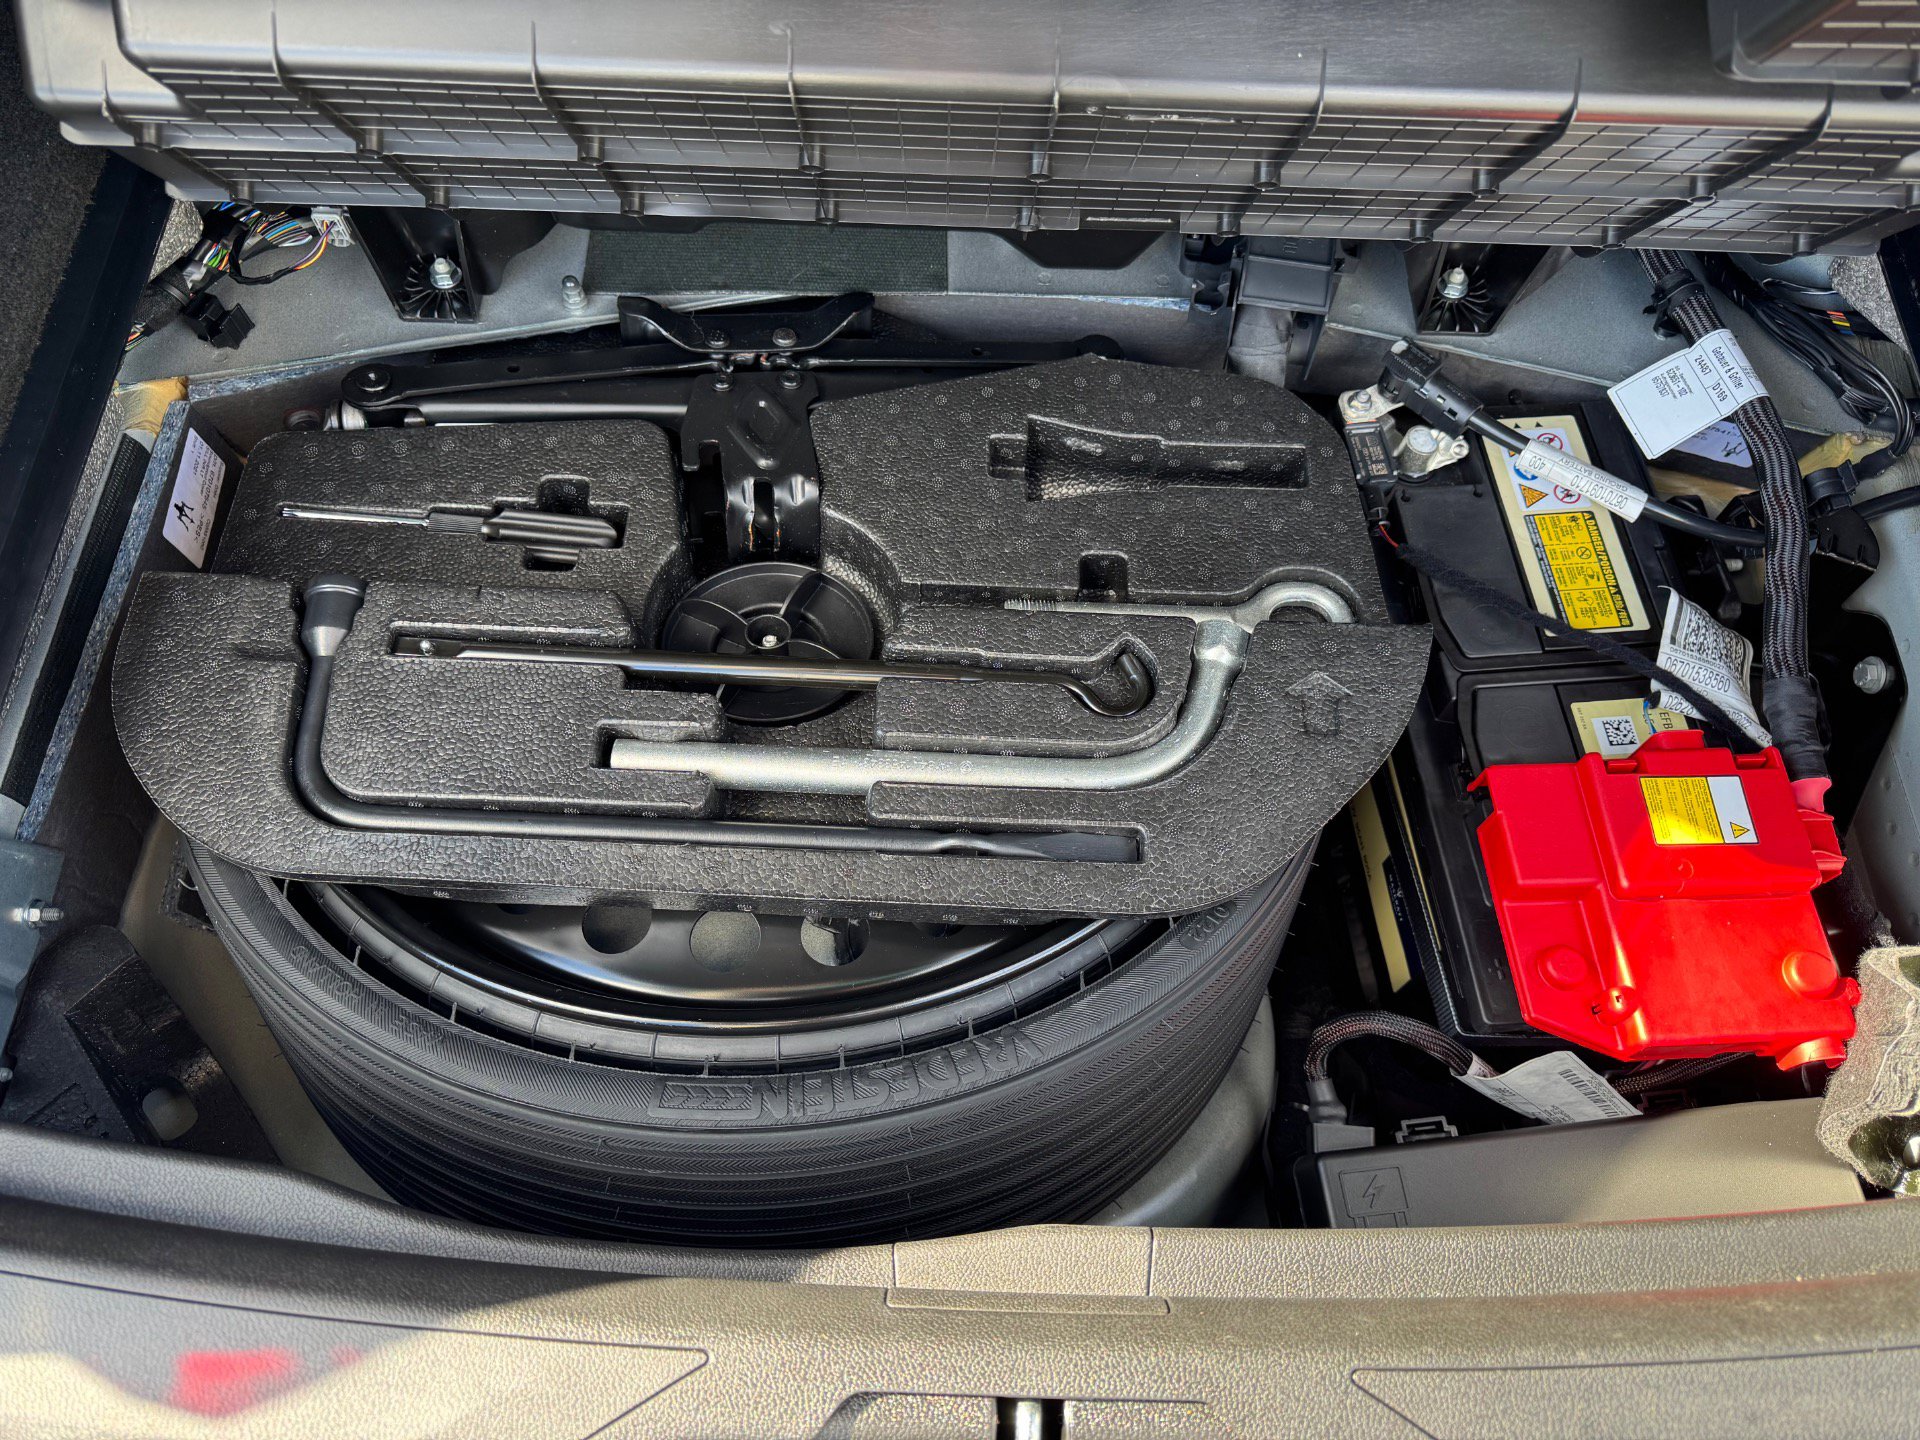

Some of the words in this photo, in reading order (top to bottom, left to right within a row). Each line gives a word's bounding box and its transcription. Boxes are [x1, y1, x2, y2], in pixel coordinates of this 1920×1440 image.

[1693, 354, 1712, 376] 24487
[1711, 345, 1732, 369] Gebauer
[1724, 366, 1735, 374] &
[1710, 382, 1729, 402] D169
[1526, 454, 1548, 472] 400
[1558, 455, 1593, 477] BATTERY
[1569, 471, 1630, 511] 06701091710
[1592, 471, 1629, 494] GROUND
[1659, 712, 1673, 728] EFB
[755, 1027, 1046, 1119] VREDESTEIN
